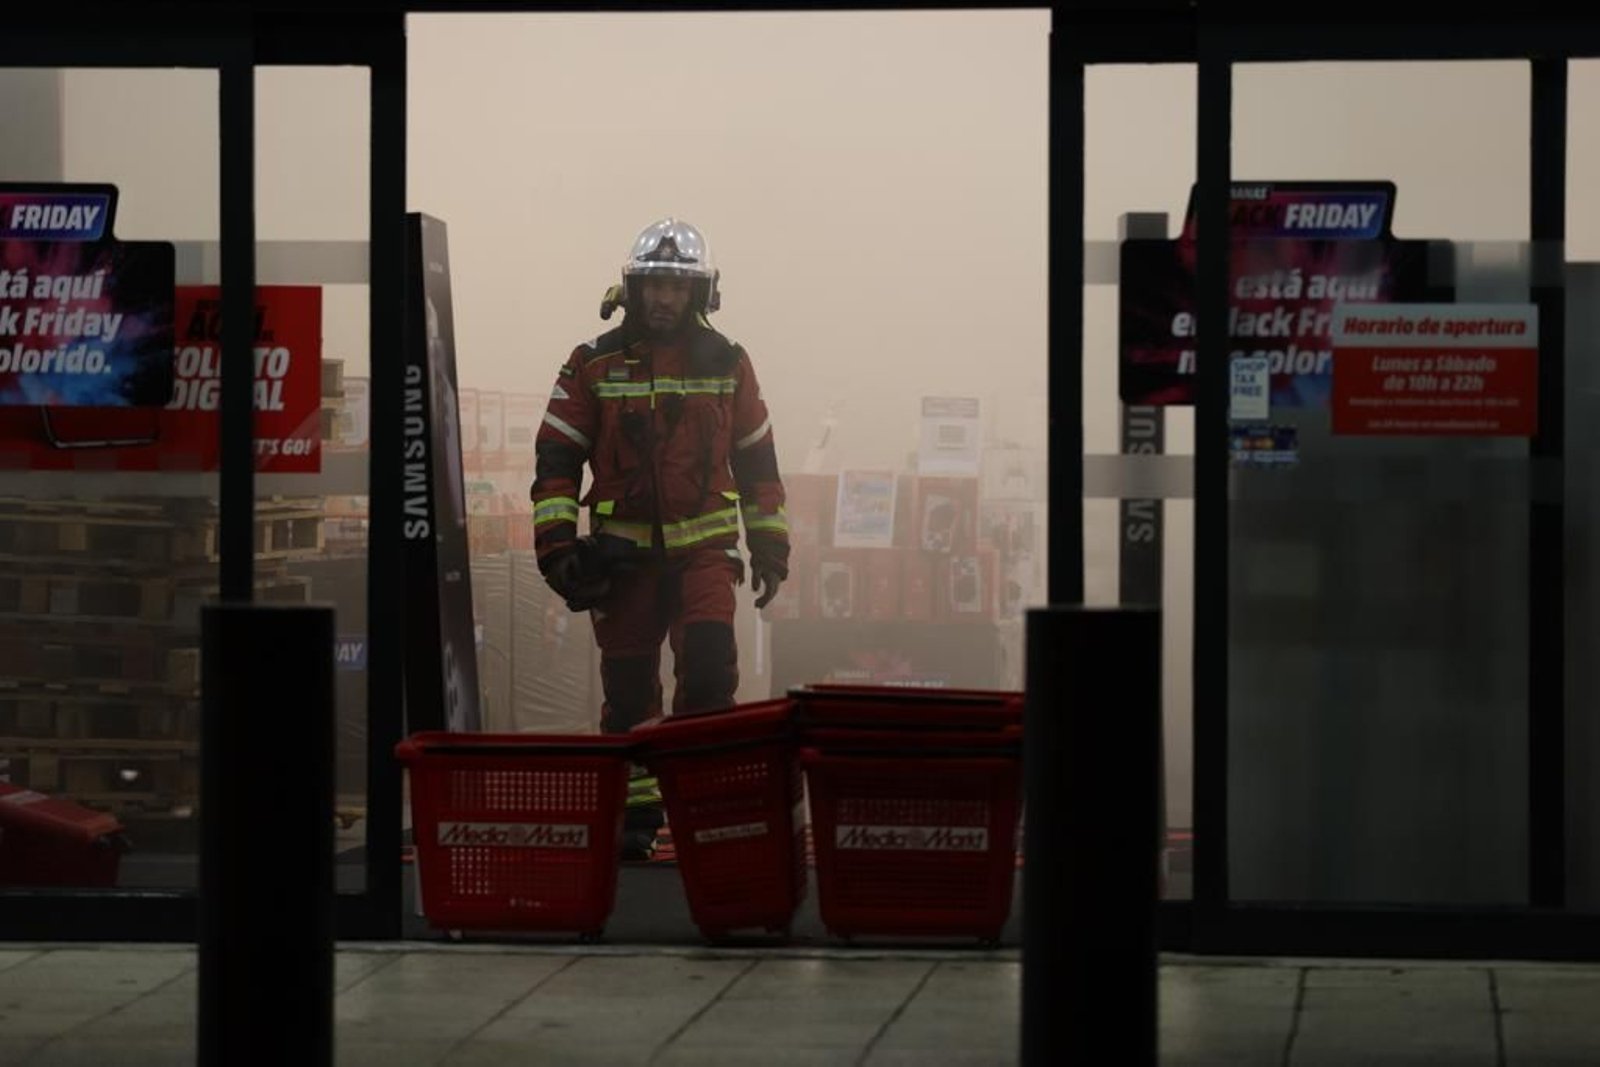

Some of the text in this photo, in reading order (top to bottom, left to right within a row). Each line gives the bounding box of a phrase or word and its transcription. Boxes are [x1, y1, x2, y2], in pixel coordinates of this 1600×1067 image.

[10, 204, 100, 230] FRIDAY
[1283, 203, 1379, 229] FRIDAY
[32, 269, 106, 304] aquí
[1235, 269, 1382, 302] está aquí
[23, 307, 124, 343] Friday
[1344, 317, 1527, 337] Horario de apertura
[174, 346, 290, 377] OLTO
[1233, 361, 1265, 372] SHOP
[1371, 355, 1420, 372] Lunes
[1422, 358, 1434, 372] a
[1233, 374, 1256, 384] TAX
[1383, 375, 1484, 391] de 10h a 22h
[164, 378, 286, 411] DIGAL
[1233, 386, 1263, 397] FREE
[282, 439, 311, 456] GO!
[404, 364, 430, 540] SAMSUNG
[441, 825, 583, 846] Media Markt
[839, 828, 983, 848] Media Markt
